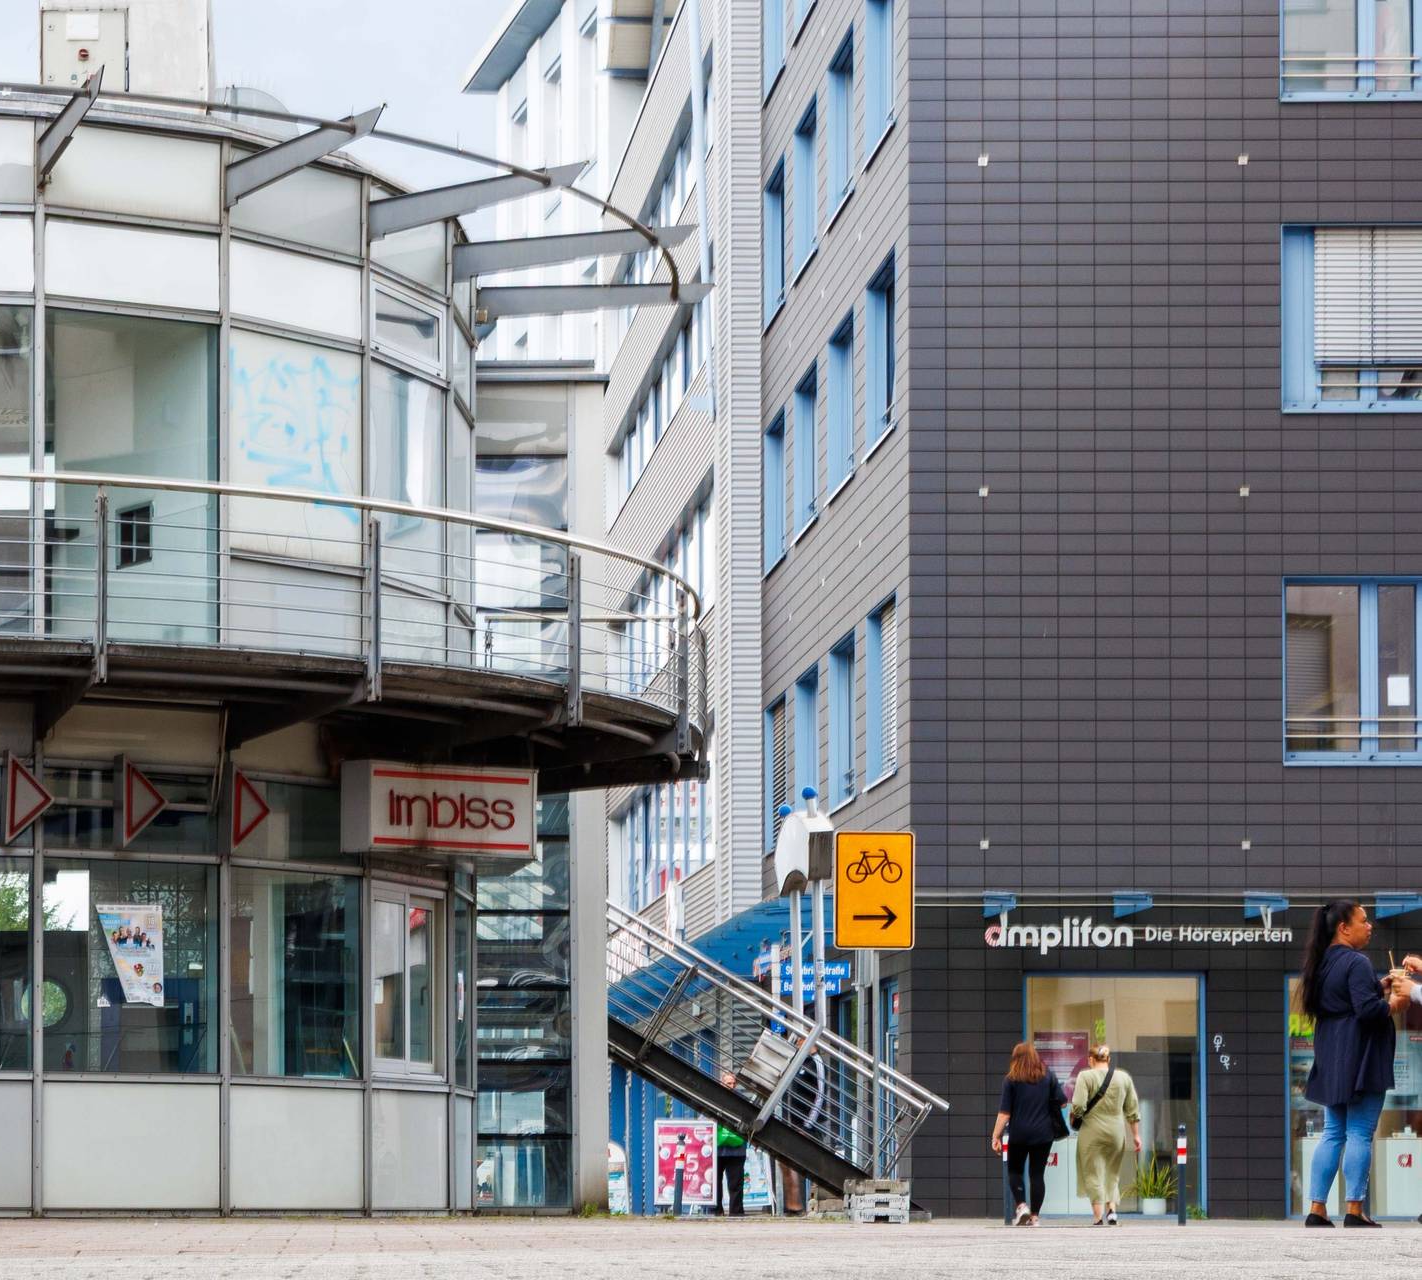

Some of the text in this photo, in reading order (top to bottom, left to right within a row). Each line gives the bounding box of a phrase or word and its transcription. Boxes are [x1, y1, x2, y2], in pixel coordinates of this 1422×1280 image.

[388, 788, 515, 830] Imbiss
[984, 917, 1293, 955] amplifon Die Hörexperten
